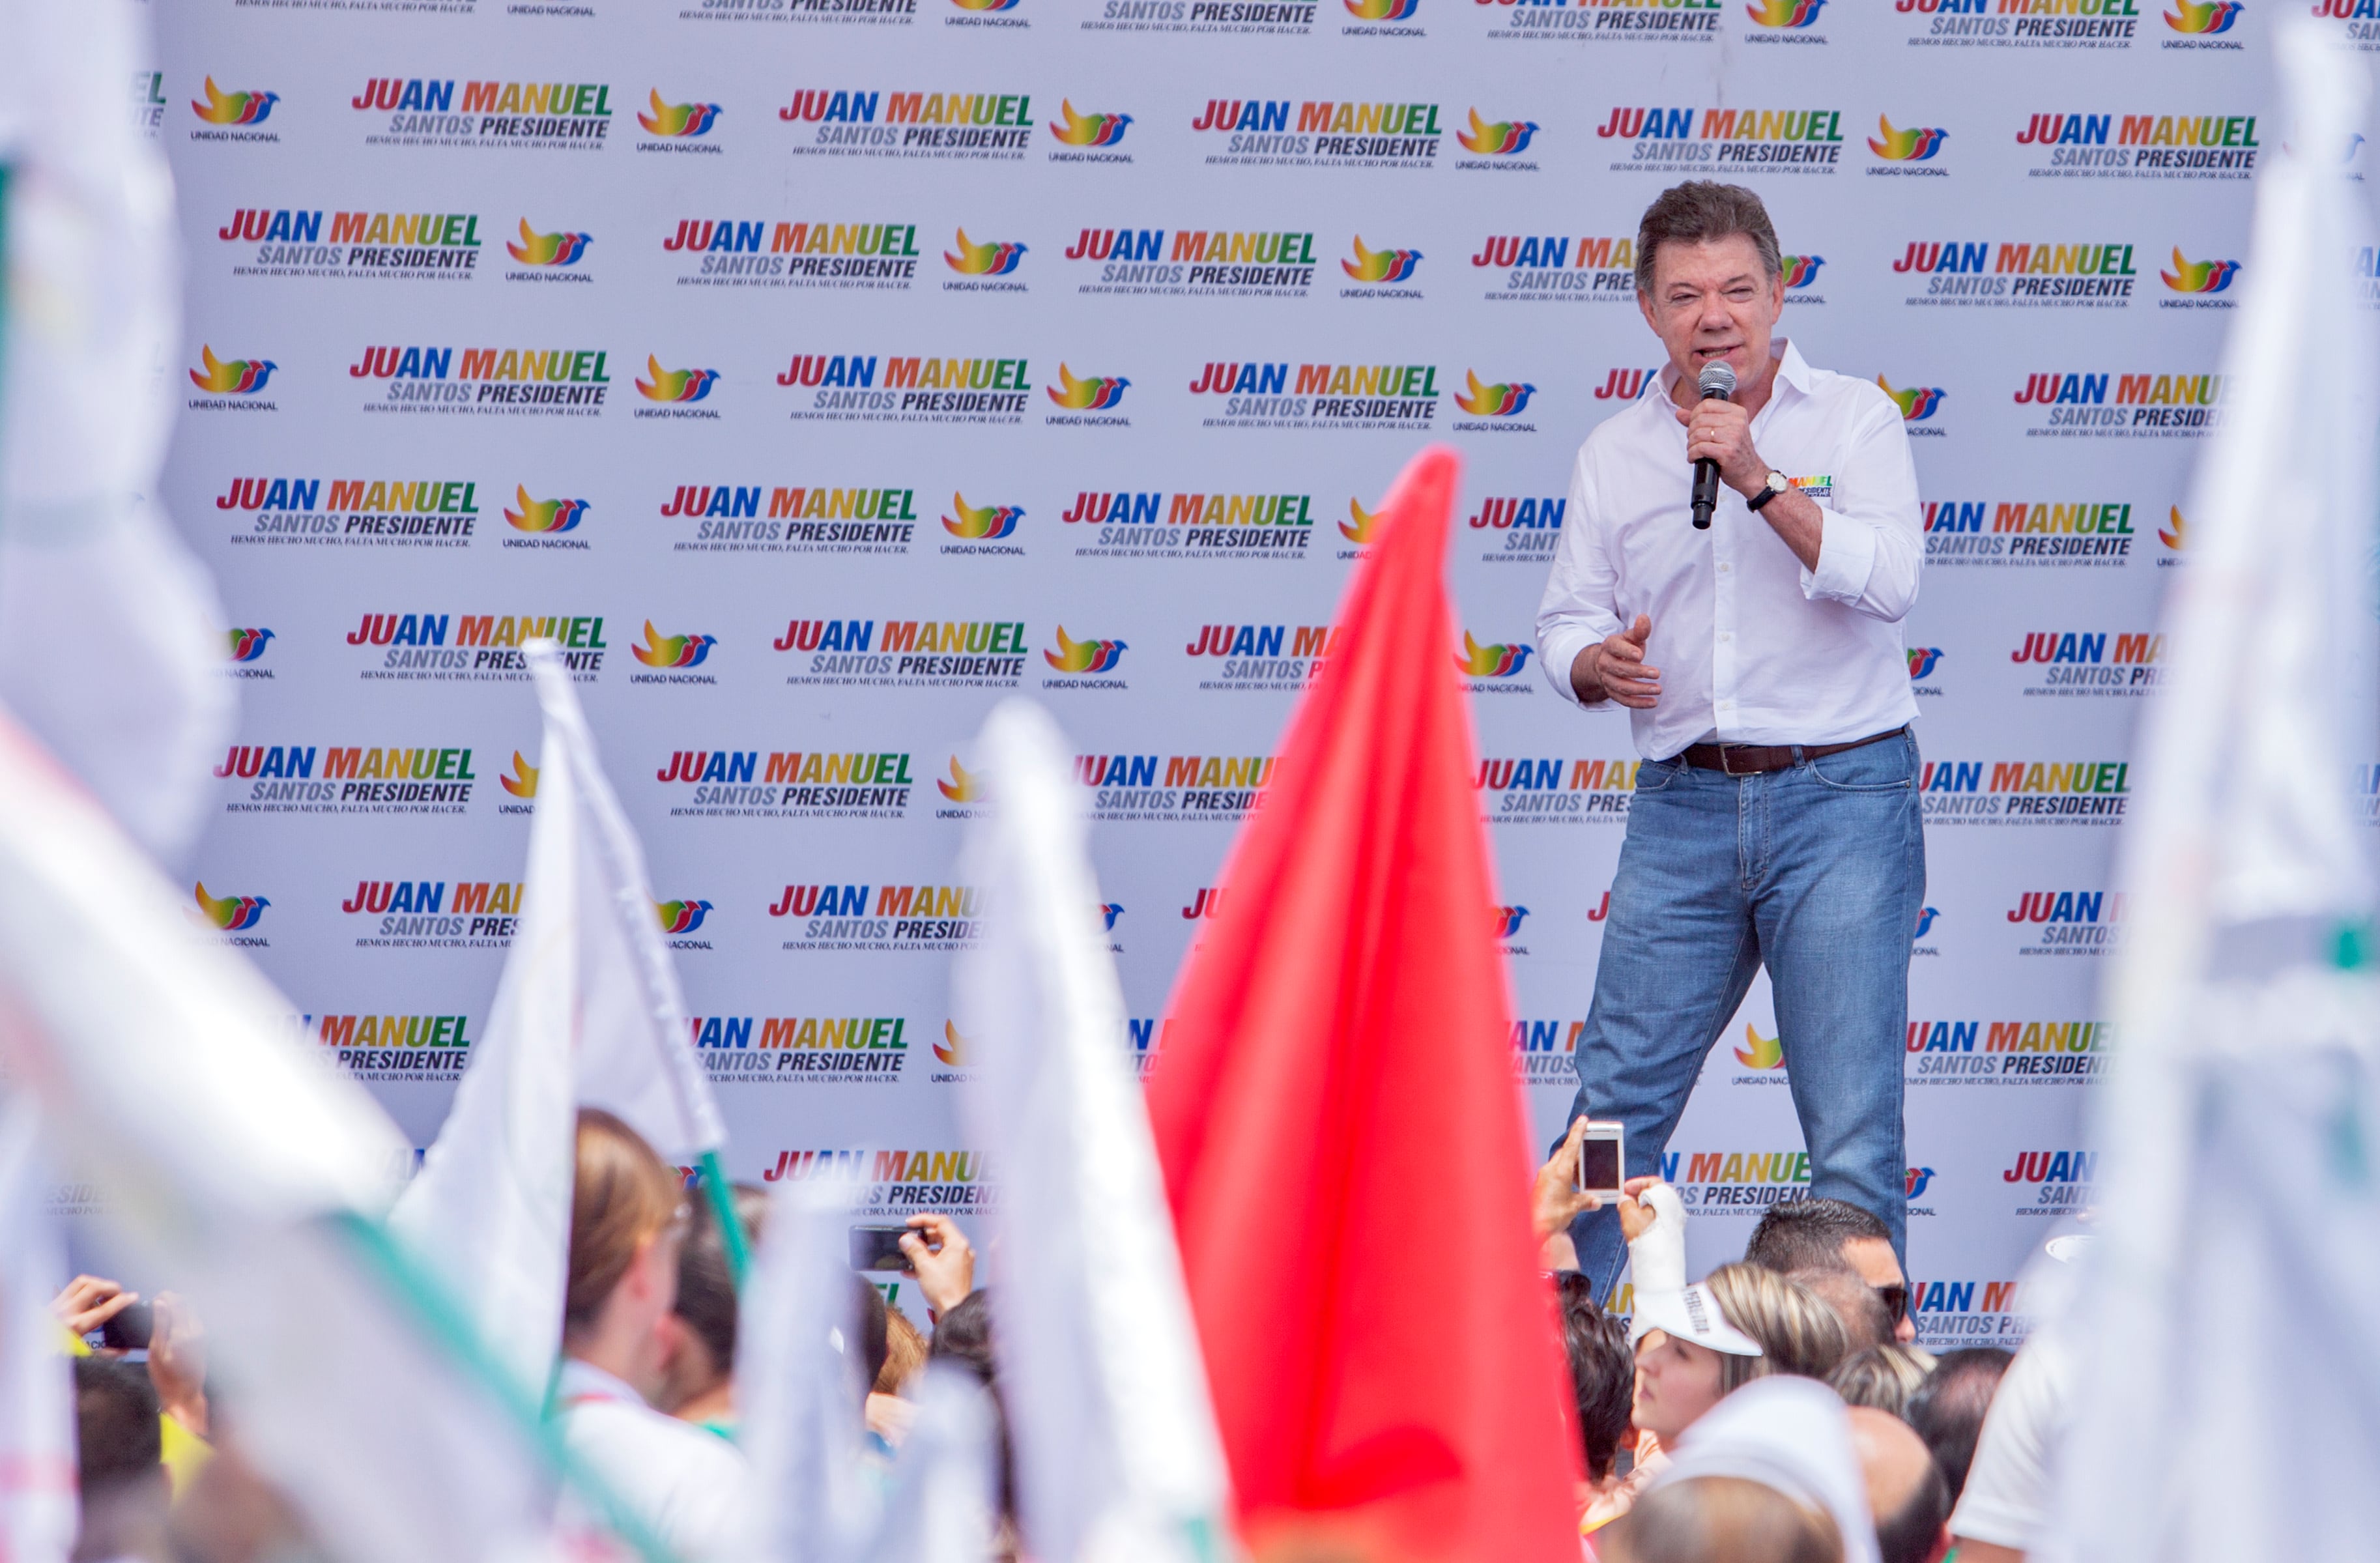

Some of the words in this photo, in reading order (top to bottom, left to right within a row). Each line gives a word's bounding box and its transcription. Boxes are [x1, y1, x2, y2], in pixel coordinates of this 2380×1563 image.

[944, 16, 982, 27] UNIDAD
[982, 17, 1031, 27] NACIONAL
[1102, 1, 1185, 22] SANTOS
[1189, 3, 1317, 25] PRESIDENTE
[1509, 8, 1590, 29] SANTOS
[1594, 10, 1720, 32] PRESIDENTE
[1341, 26, 1378, 37] UNIDAD
[1378, 27, 1427, 37] NACIONAL
[1929, 16, 2010, 36] SANTOS
[2014, 17, 2138, 38] PRESIDENTE
[2162, 39, 2198, 50] UNIDAD
[2198, 40, 2245, 50] NACIONAL
[351, 78, 455, 112] JUAN
[461, 80, 612, 117] MANUEL
[778, 90, 880, 123] JUAN
[885, 92, 1034, 127] MANUEL
[388, 113, 474, 135] SANTOS
[479, 116, 610, 139] PRESIDENTE
[1191, 100, 1291, 132] JUAN
[1297, 101, 1442, 136] MANUEL
[1596, 108, 1695, 139] JUAN
[1700, 108, 1844, 142] MANUEL
[2015, 113, 2112, 145] JUAN
[2117, 114, 2259, 147] MANUEL
[190, 130, 229, 141] UNIDAD
[229, 131, 281, 143] NACIONAL
[814, 124, 899, 146] SANTOS
[903, 127, 1032, 149] PRESIDENTE
[1227, 134, 1310, 154] SANTOS
[1313, 136, 1441, 158] PRESIDENTE
[1048, 151, 1085, 163] UNIDAD
[1085, 152, 1135, 164] NACIONAL
[1631, 141, 1713, 162] SANTOS
[1717, 143, 1842, 164] PRESIDENTE
[2050, 147, 2130, 167] SANTOS
[2134, 149, 2258, 169] PRESIDENTE
[1865, 165, 1902, 177] UNIDAD
[1902, 166, 1950, 177] NACIONAL
[218, 209, 323, 243] JUAN
[328, 211, 481, 247] MANUEL
[663, 220, 765, 253] JUAN
[770, 222, 920, 257] MANUEL
[256, 244, 343, 266] SANTOS
[347, 247, 480, 269] PRESIDENTE
[1064, 229, 1165, 261] JUAN
[1170, 230, 1317, 265] MANUEL
[1470, 237, 1570, 268] JUAN
[1891, 242, 1989, 274] JUAN
[1994, 242, 2137, 276] MANUEL
[504, 270, 543, 282] UNIDAD
[543, 272, 594, 283] NACIONAL
[699, 255, 784, 276] SANTOS
[788, 257, 918, 278] PRESIDENTE
[1100, 263, 1183, 283] SANTOS
[1187, 265, 1315, 286] PRESIDENTE
[1506, 270, 1588, 291] SANTOS
[1927, 276, 2007, 295] SANTOS
[2011, 277, 2135, 297] PRESIDENTE
[1340, 287, 1376, 298] UNIDAD
[1376, 289, 1424, 299] NACIONAL
[349, 346, 453, 380] JUAN
[458, 348, 610, 383] MANUEL
[776, 355, 878, 388] JUAN
[883, 356, 1031, 391] MANUEL
[1188, 362, 1289, 395] JUAN
[1294, 364, 1440, 397] MANUEL
[2013, 373, 2110, 405] JUAN
[386, 381, 472, 402] SANTOS
[476, 383, 609, 405] PRESIDENTE
[812, 390, 896, 410] SANTOS
[900, 392, 1029, 413] PRESIDENTE
[633, 407, 671, 419] UNIDAD
[671, 408, 721, 419] NACIONAL
[1225, 397, 1307, 417] SANTOS
[1311, 398, 1438, 419] PRESIDENTE
[2048, 407, 2128, 426] SANTOS
[1452, 421, 1489, 432] UNIDAD
[1489, 422, 1538, 433] NACIONAL
[216, 478, 321, 511] JUAN
[326, 479, 479, 513] MANUEL
[659, 485, 762, 518] JUAN
[767, 487, 917, 521] MANUEL
[1061, 493, 1162, 524] JUAN
[1167, 493, 1314, 526] MANUEL
[1469, 497, 1568, 529] JUAN
[1992, 502, 2134, 534] MANUEL
[253, 513, 340, 534] SANTOS
[344, 515, 477, 536] PRESIDENTE
[696, 520, 781, 540] SANTOS
[785, 522, 915, 543] PRESIDENTE
[1097, 526, 1181, 546] SANTOS
[1184, 528, 1312, 548] PRESIDENTE
[1925, 536, 2005, 554] SANTOS
[2009, 536, 2133, 555] PRESIDENTE
[939, 544, 977, 555] UNIDAD
[977, 545, 1026, 555] NACIONAL
[346, 614, 450, 646] JUAN
[773, 620, 874, 652] JUAN
[880, 620, 1028, 654] MANUEL
[1186, 625, 1285, 657] JUAN
[384, 648, 470, 669] SANTOS
[2010, 632, 2107, 664] JUAN
[809, 654, 893, 674] SANTOS
[897, 655, 1026, 676] PRESIDENTE
[1222, 659, 1304, 679] SANTOS
[2044, 666, 2125, 685] SANTOS
[212, 746, 317, 779] JUAN
[323, 747, 476, 780] MANUEL
[656, 751, 758, 783] JUAN
[764, 751, 913, 784] MANUEL
[1465, 758, 1564, 791] JUAN
[1988, 761, 2131, 794] MANUEL
[250, 781, 336, 801] SANTOS
[340, 782, 474, 803] PRESIDENTE
[693, 785, 777, 805] SANTOS
[781, 786, 911, 807] PRESIDENTE
[1094, 790, 1177, 809] SANTOS
[1500, 793, 1582, 812] SANTOS
[1921, 796, 2001, 815] SANTOS
[2005, 796, 2129, 814] PRESIDENTE
[341, 881, 446, 913] JUAN
[768, 885, 870, 917] JUAN
[2007, 891, 2104, 923] JUAN
[379, 916, 465, 936] SANTOS
[805, 919, 889, 939] SANTOS
[319, 1015, 470, 1048] MANUEL
[758, 1017, 908, 1050] MANUEL
[776, 1052, 906, 1072] PRESIDENTE
[1917, 1055, 1998, 1074] SANTOS
[1685, 1151, 1812, 1184] MANUE
